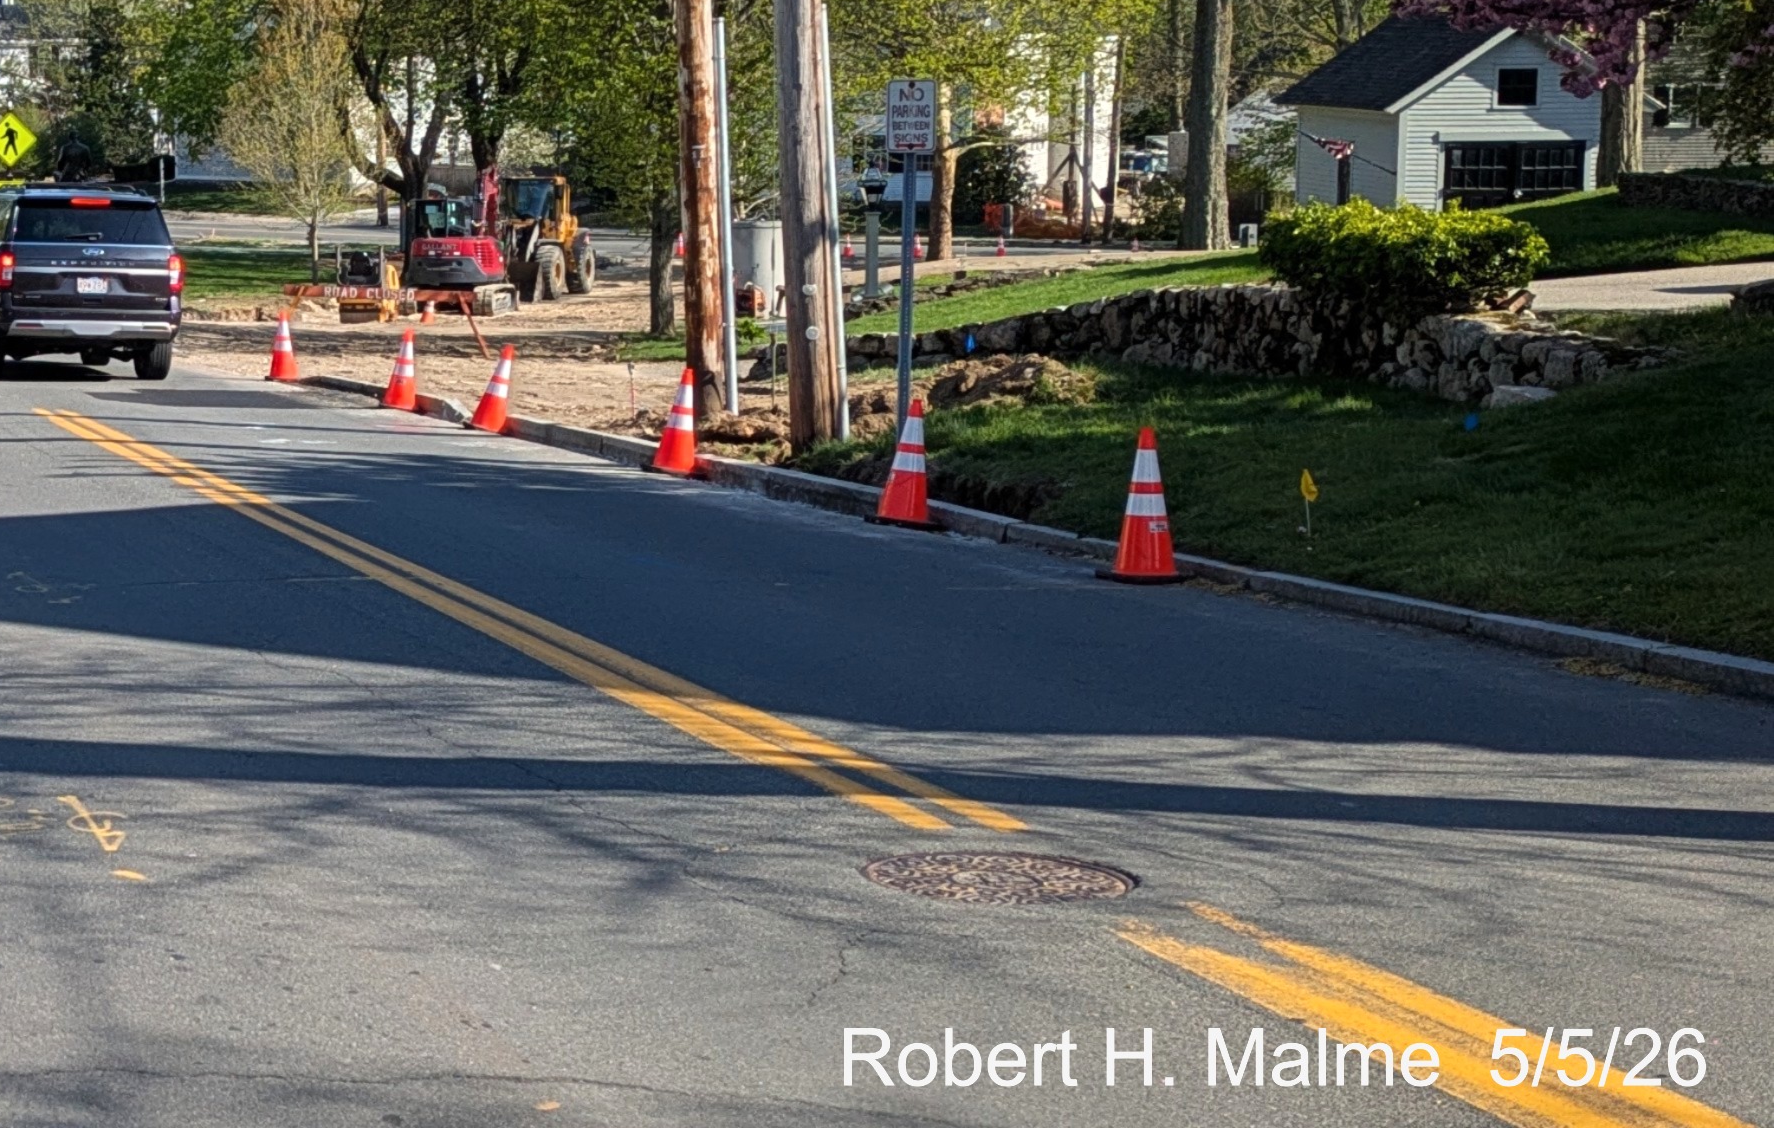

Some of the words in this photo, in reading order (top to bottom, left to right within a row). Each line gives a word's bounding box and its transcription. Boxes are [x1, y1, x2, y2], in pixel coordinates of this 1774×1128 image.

[899, 88, 925, 102] NO
[892, 104, 930, 118] PARKING
[892, 121, 930, 131] BETWEEN
[893, 133, 929, 143] SIGNS
[324, 286, 358, 299] ROAD
[366, 287, 416, 301] CLOSED
